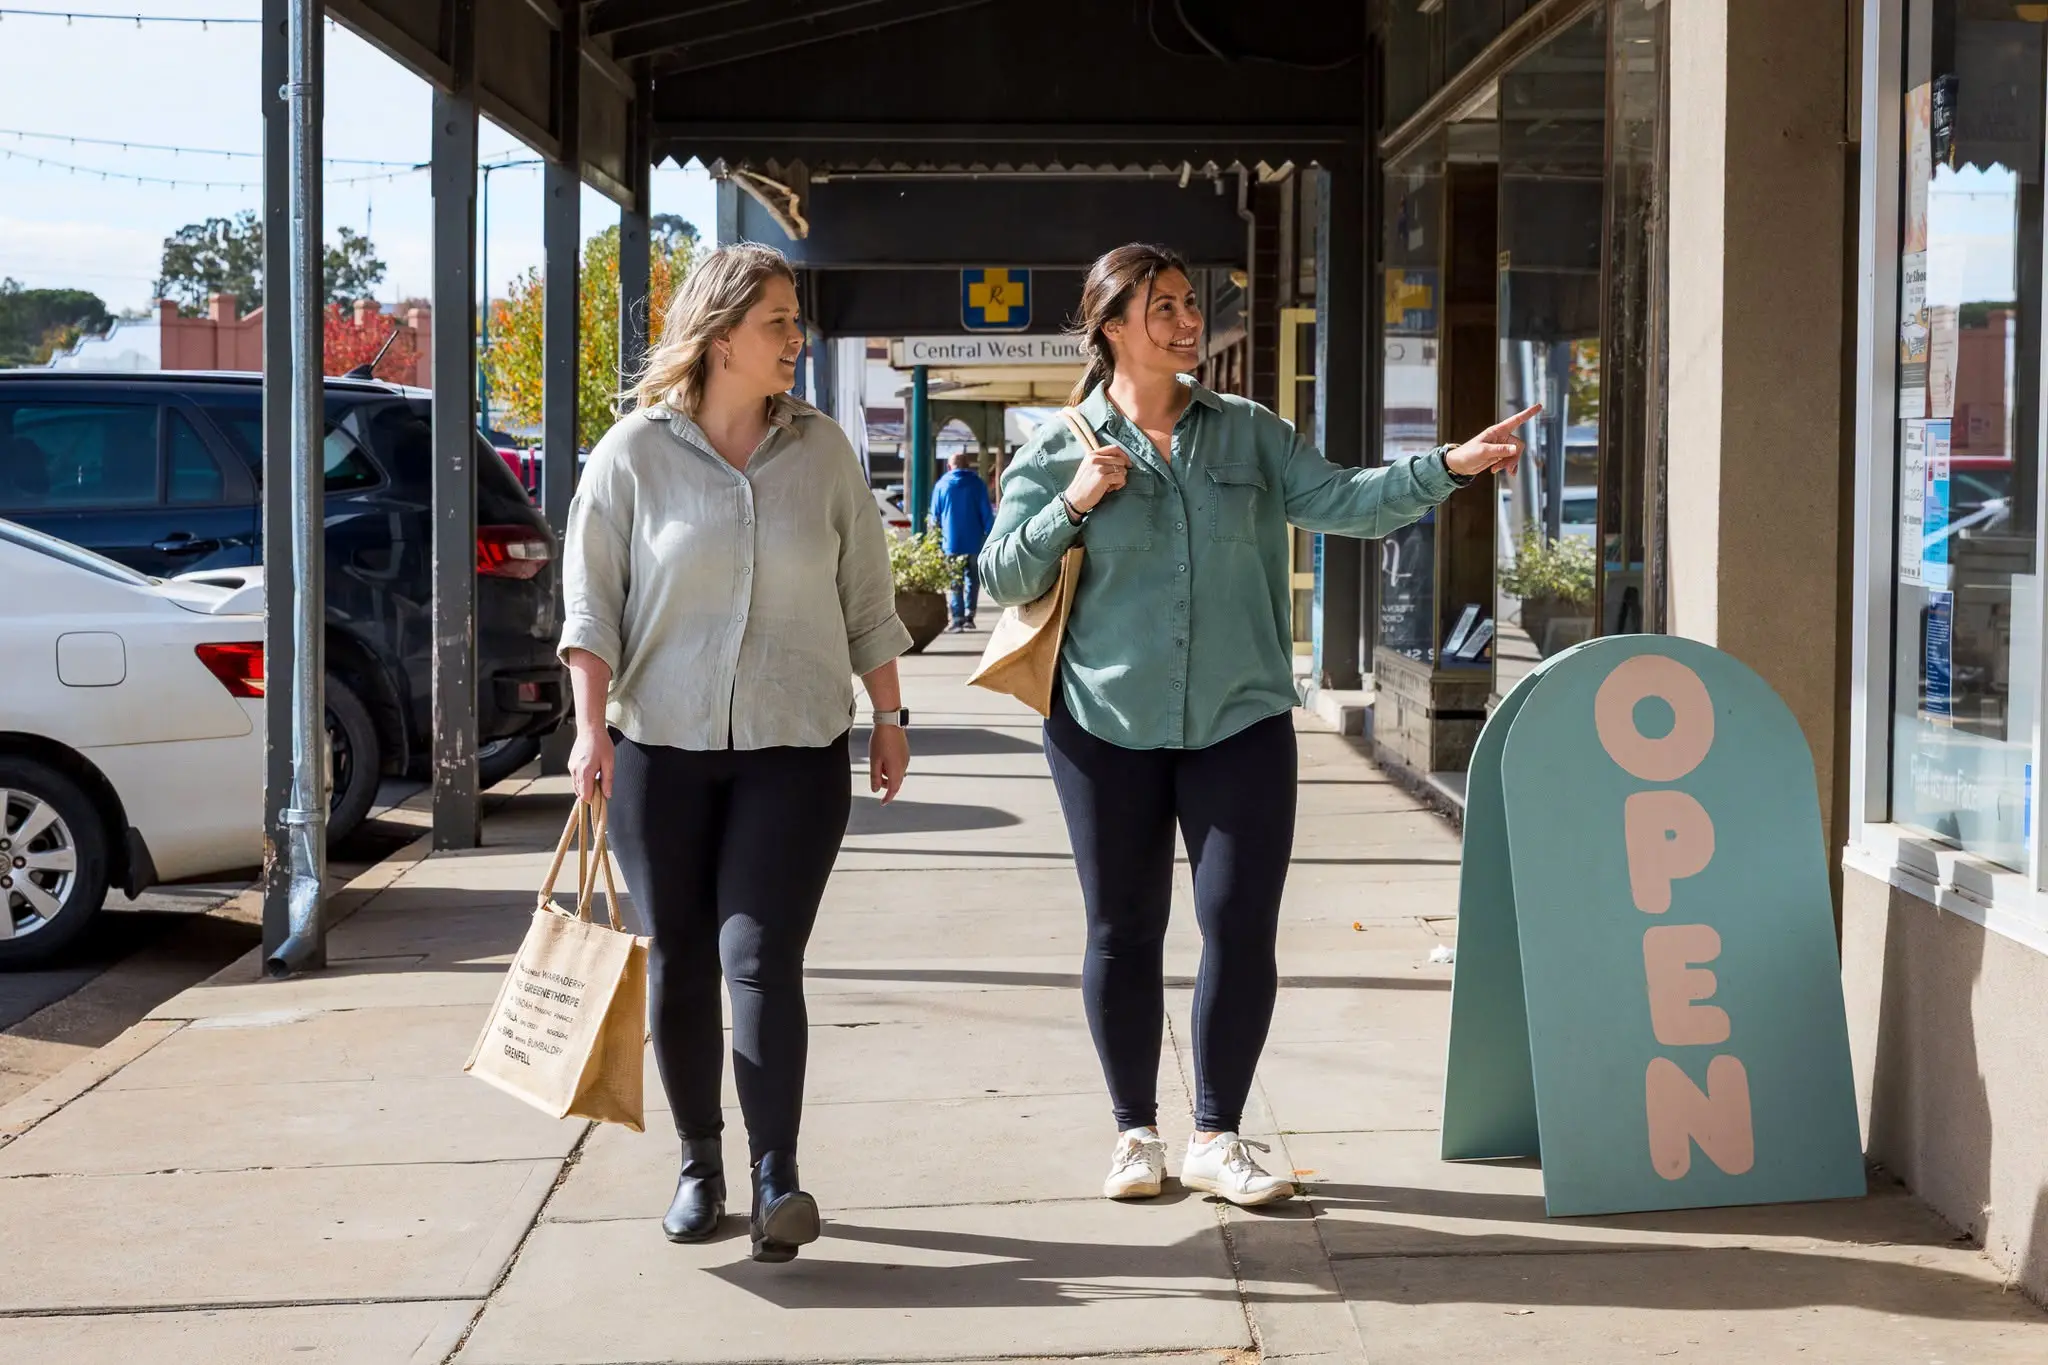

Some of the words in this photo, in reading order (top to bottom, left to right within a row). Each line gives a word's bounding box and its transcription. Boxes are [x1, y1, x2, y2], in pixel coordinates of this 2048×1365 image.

[913, 341, 980, 358] Central
[986, 342, 1034, 358] West
[1594, 653, 1754, 1181] OPEN
[524, 983, 580, 1008] GREENETHORPE
[504, 1044, 530, 1066] GRENFELL
